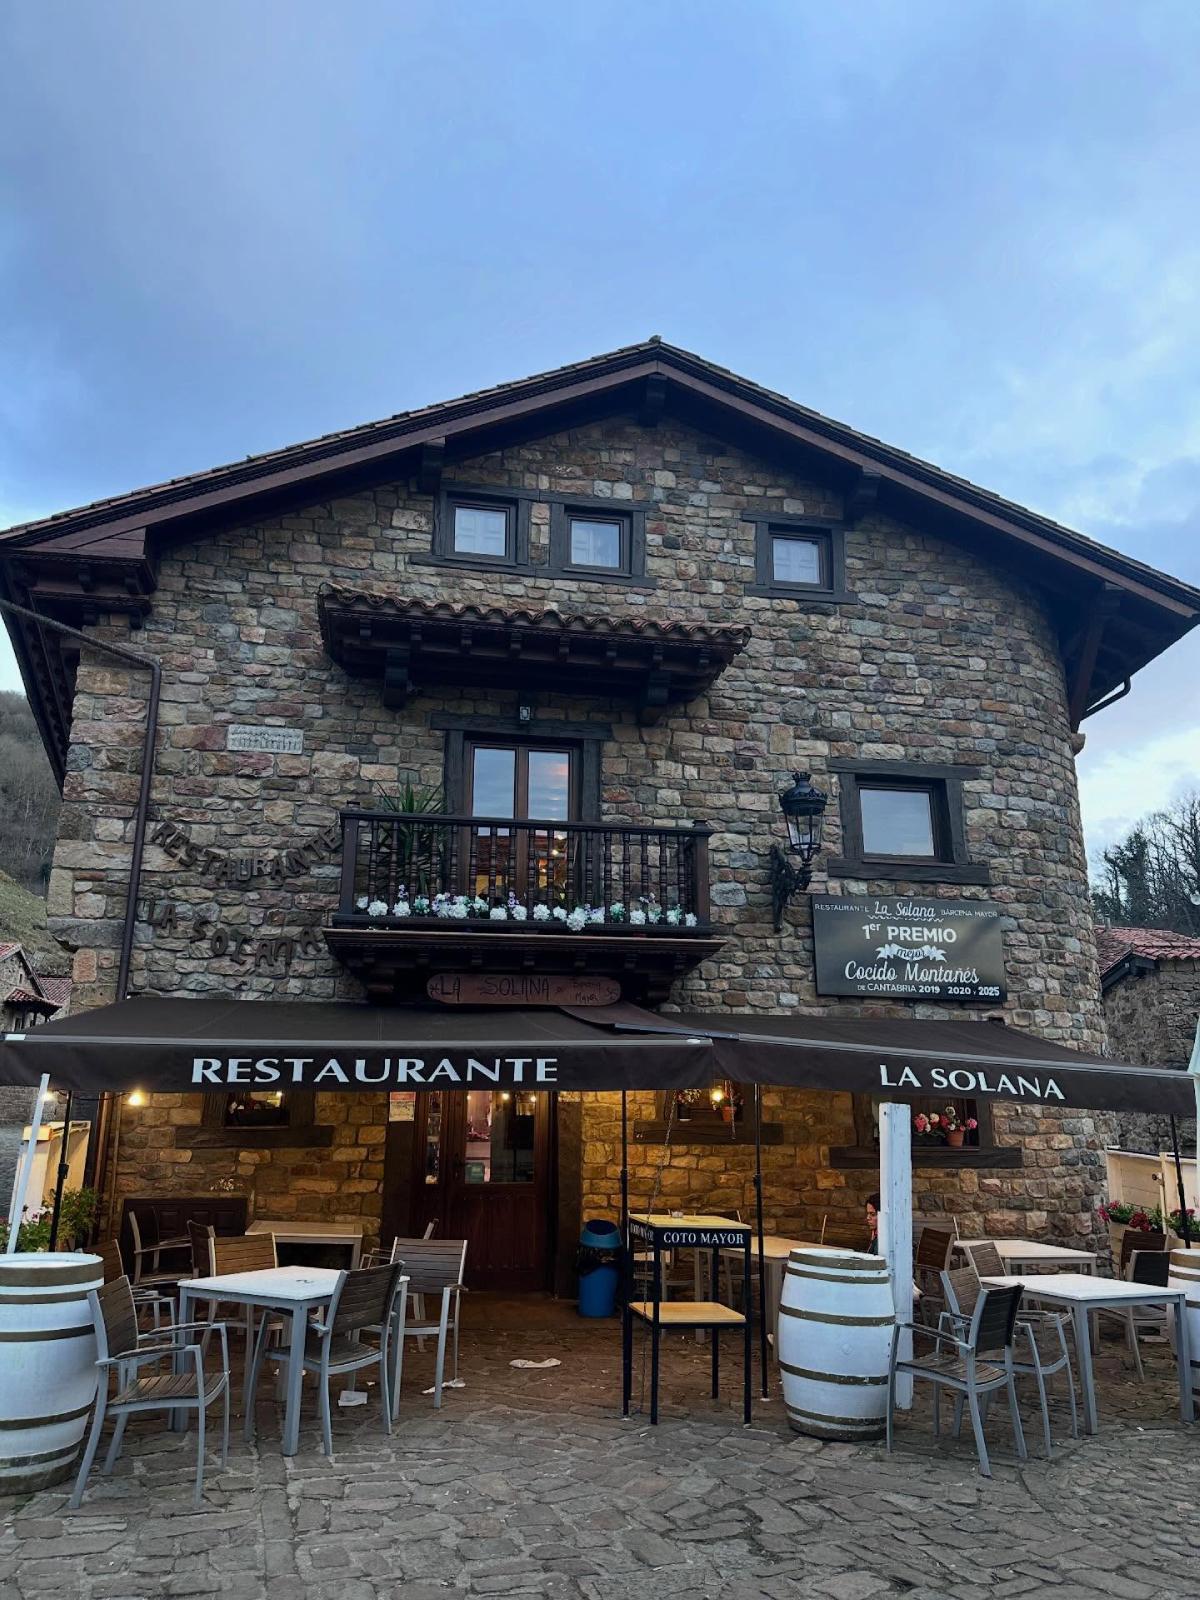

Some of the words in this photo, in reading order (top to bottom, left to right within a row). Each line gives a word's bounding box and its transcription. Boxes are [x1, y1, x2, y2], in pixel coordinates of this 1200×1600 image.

[152, 821, 343, 881] RESTAURANTE
[150, 900, 177, 929] LA
[814, 903, 869, 913] RESTAURANTE
[874, 901, 891, 915] La
[895, 902, 936, 917] Solana
[975, 910, 998, 918] MAYOR
[190, 917, 322, 966] SOLANA
[887, 926, 958, 943] PREMIO
[845, 961, 898, 981] Cocido
[904, 963, 979, 984] Montañés
[439, 975, 461, 1002] LA
[480, 976, 550, 1002] SOLANA
[868, 983, 917, 992] CANTABRIA
[919, 985, 941, 993] 2019
[947, 986, 971, 995] 2020
[978, 987, 1000, 996] 2025
[192, 1058, 557, 1083] RESTAURANTE
[880, 1064, 922, 1088] LA
[930, 1068, 1065, 1100] SOLANA
[663, 1231, 697, 1244] COTO
[700, 1232, 745, 1245] MAYOR
